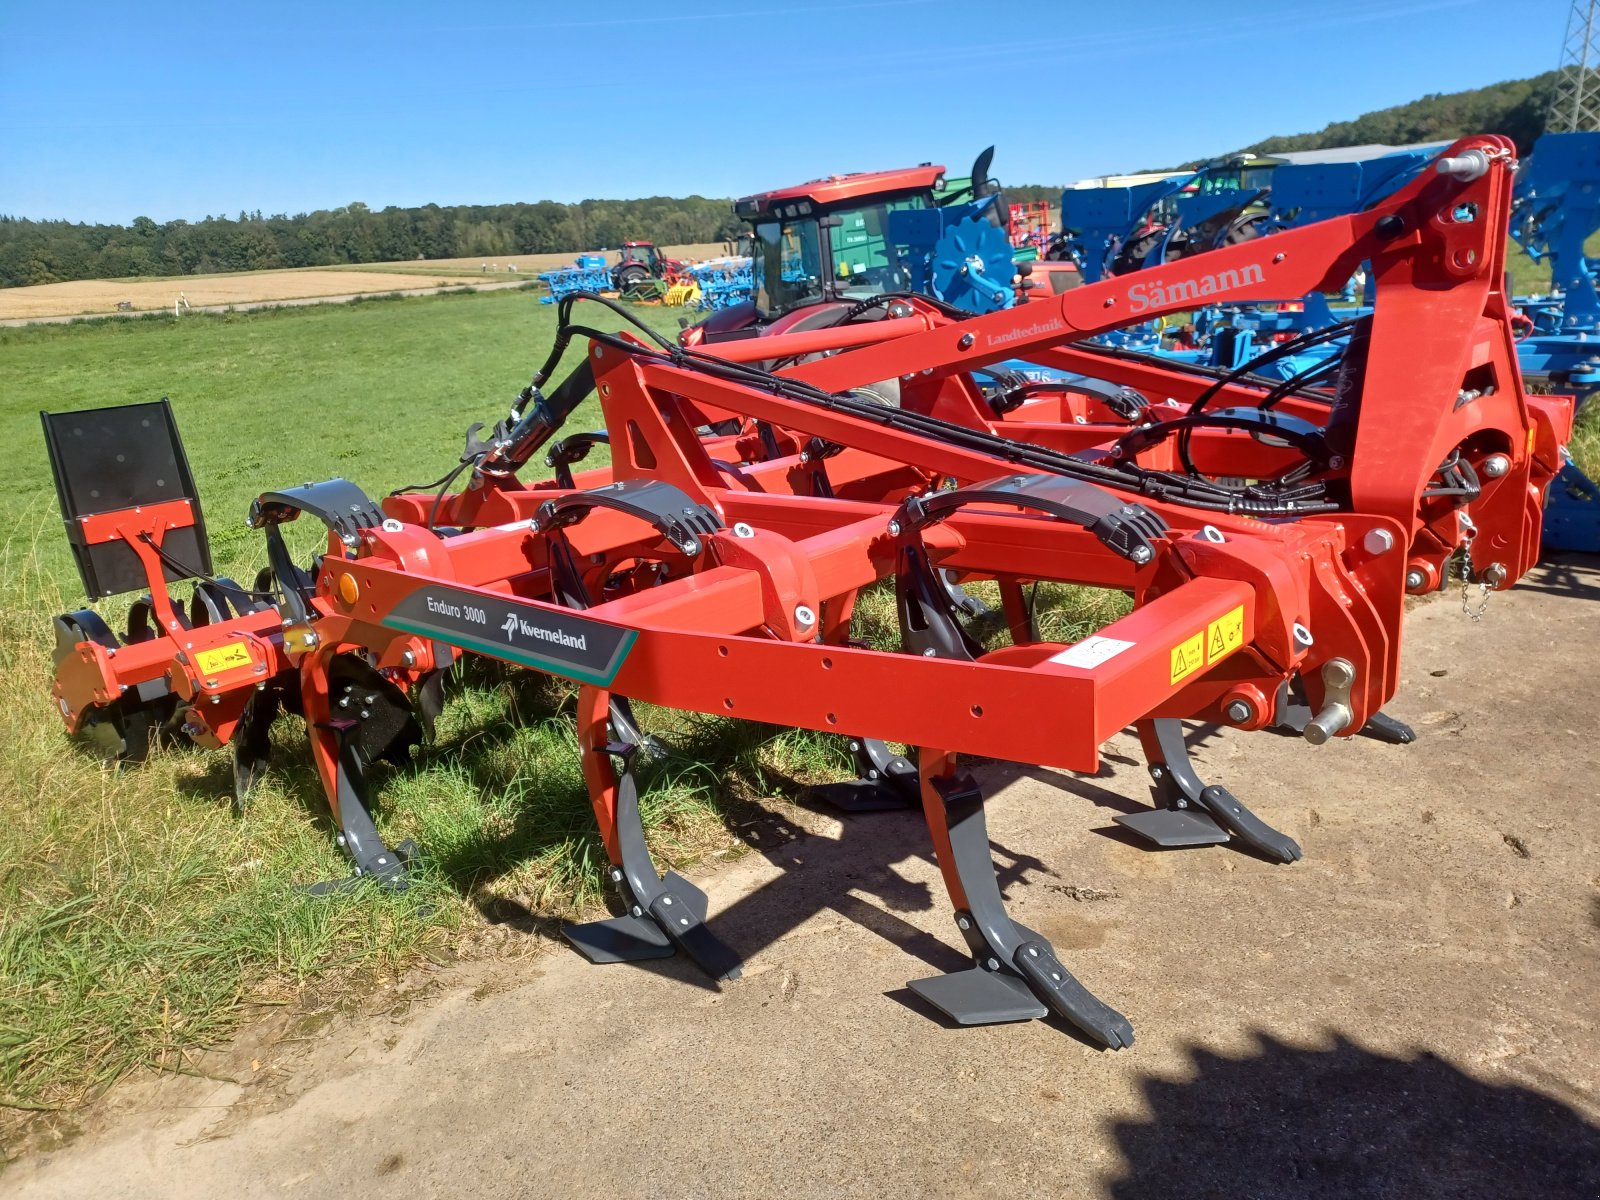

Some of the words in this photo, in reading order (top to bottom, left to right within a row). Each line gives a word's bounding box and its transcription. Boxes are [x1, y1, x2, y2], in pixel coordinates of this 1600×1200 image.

[986, 318, 1064, 347] Landtechnik
[1127, 263, 1265, 312] Sämann
[427, 597, 461, 618] Enduro
[463, 605, 486, 625] 3000
[519, 619, 587, 651] Kverneland
